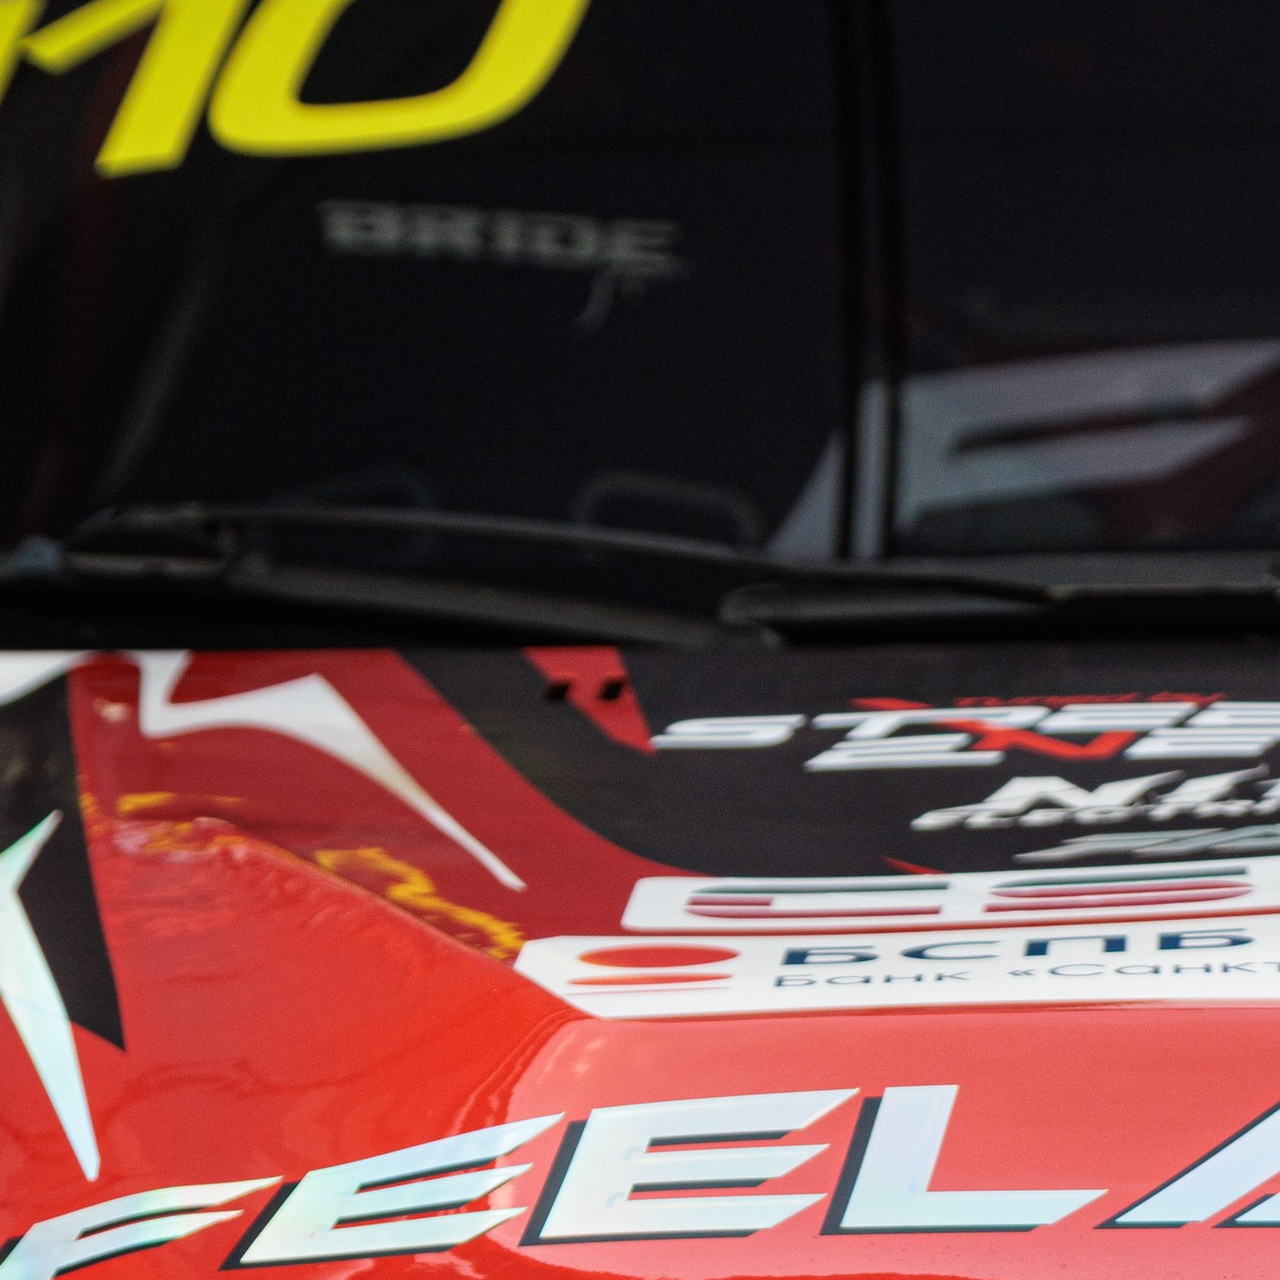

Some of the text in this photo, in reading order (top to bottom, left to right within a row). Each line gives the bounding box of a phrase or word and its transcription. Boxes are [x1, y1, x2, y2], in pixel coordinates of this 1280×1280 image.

[318, 198, 688, 278] BRIDE
[780, 927, 1256, 966] БСПБ
[772, 971, 973, 988] Банк
